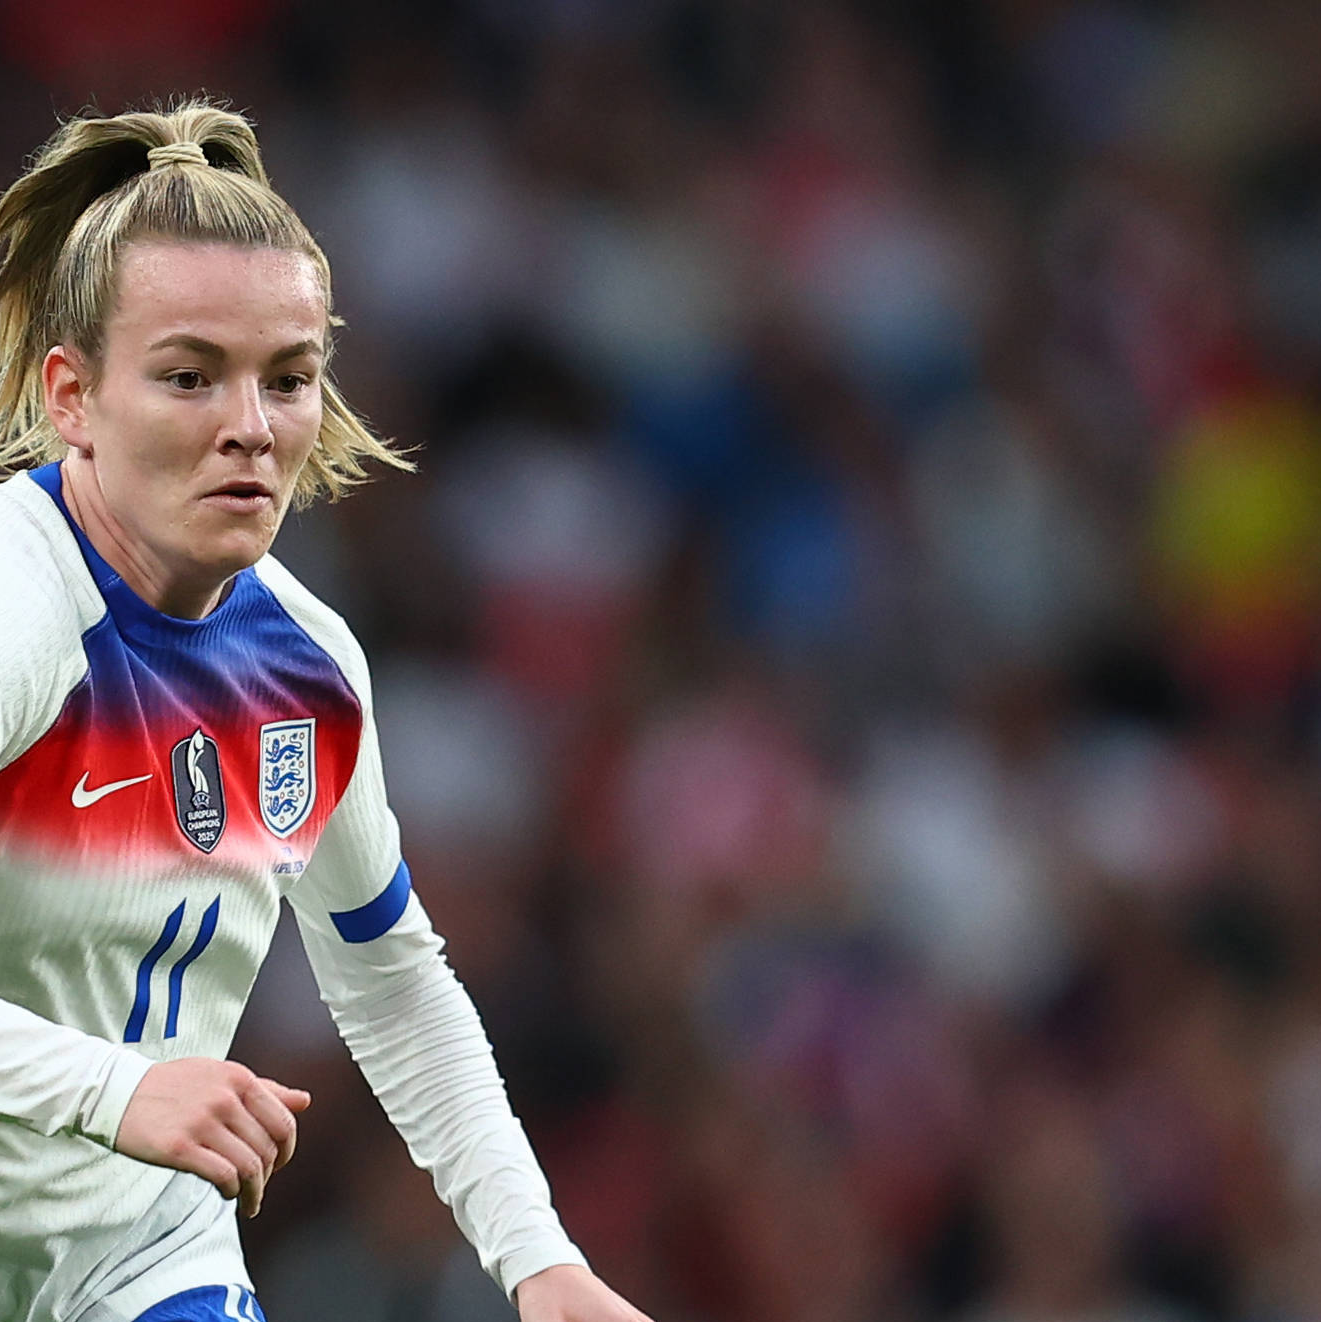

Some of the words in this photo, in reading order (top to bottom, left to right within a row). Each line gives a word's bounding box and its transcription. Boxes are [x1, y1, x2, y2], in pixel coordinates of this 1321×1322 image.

[187, 809, 218, 820] EUROPEAN
[187, 818, 221, 831] CHAMPIONS
[197, 831, 216, 842] 2025
[123, 892, 221, 1043] 11
